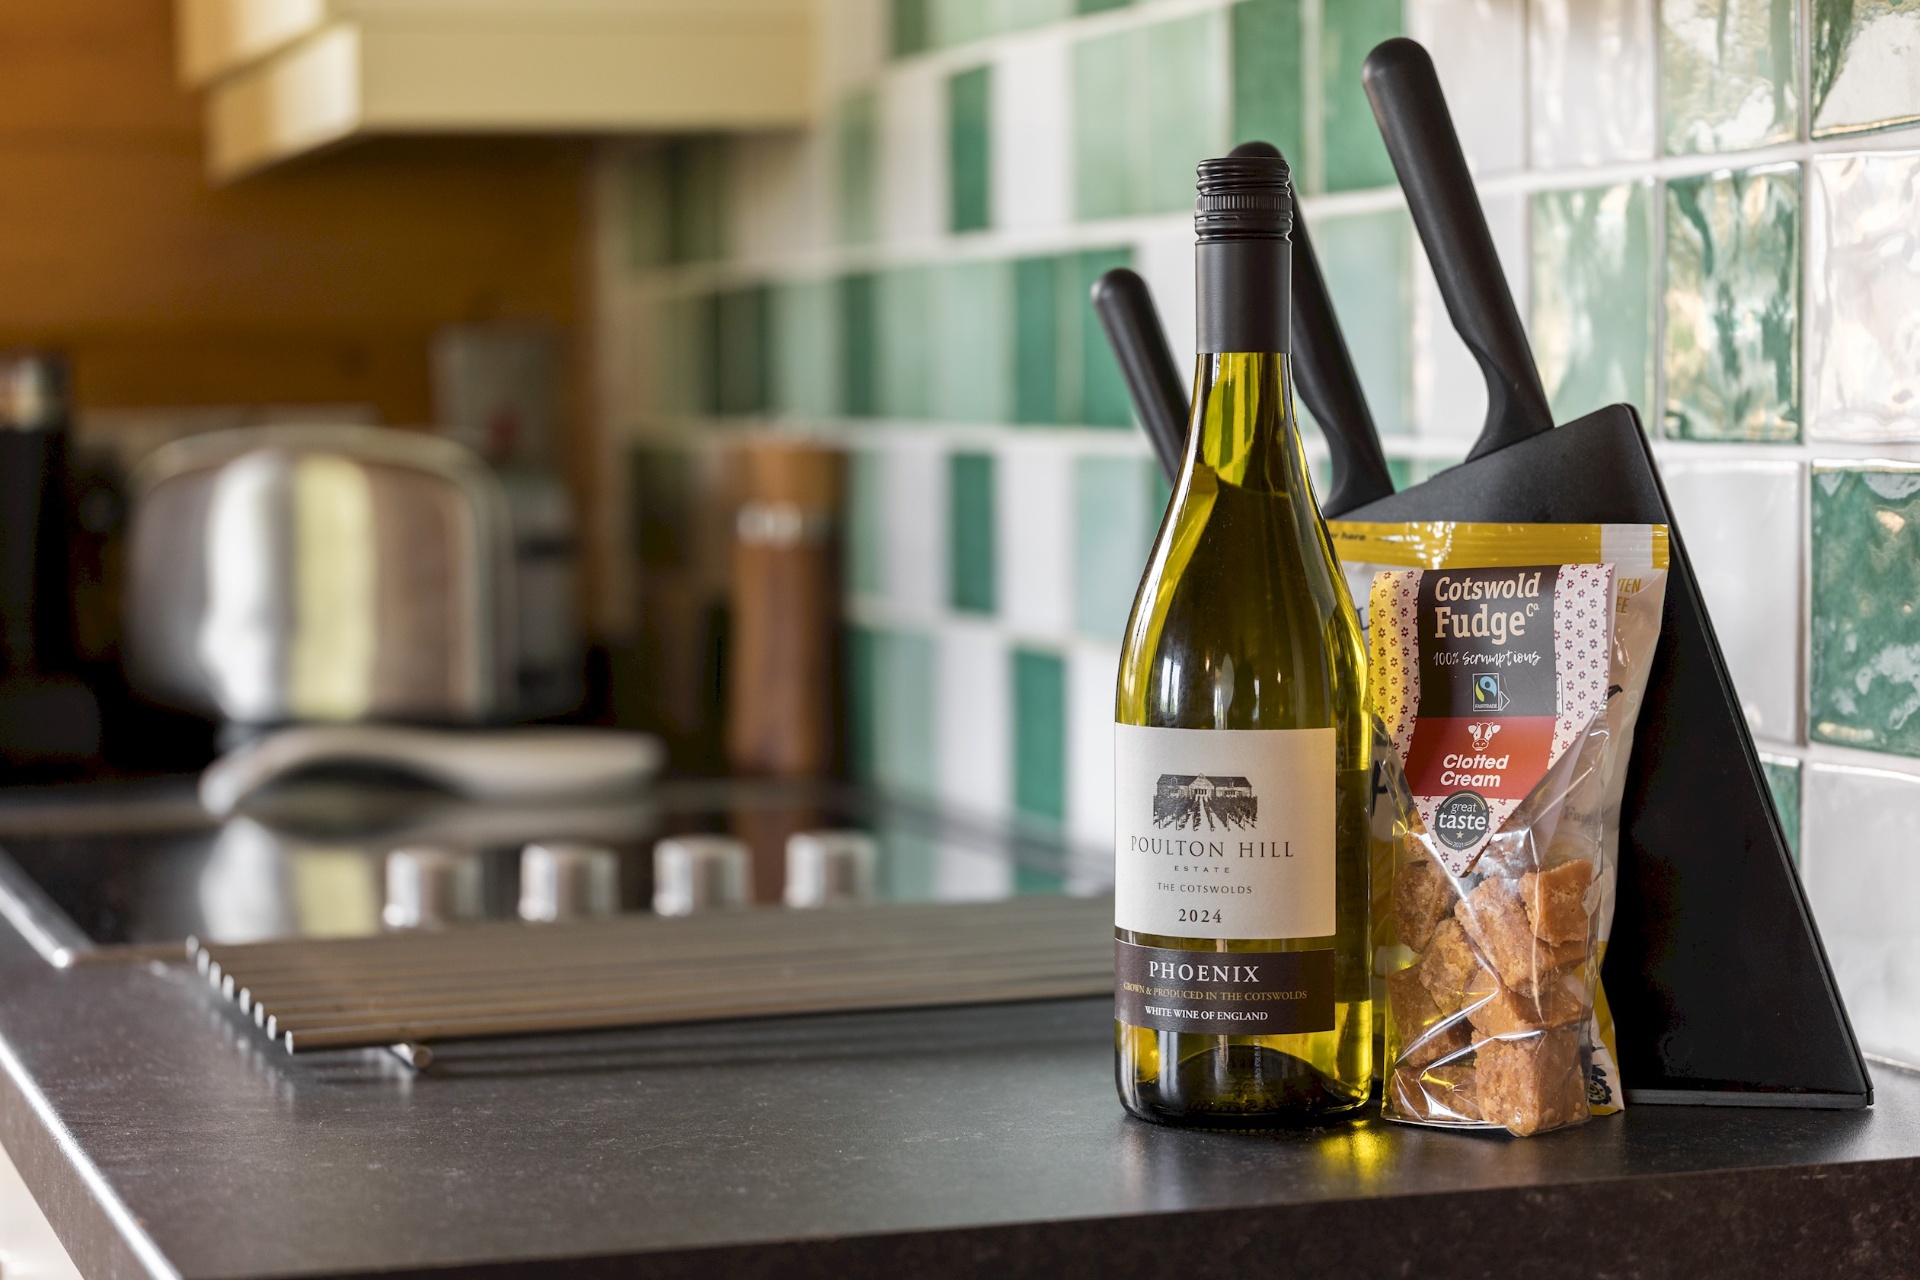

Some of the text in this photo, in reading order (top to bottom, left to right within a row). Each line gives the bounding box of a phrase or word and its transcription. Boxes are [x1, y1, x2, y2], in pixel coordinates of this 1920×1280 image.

[1435, 572, 1541, 602] Cotswold
[1435, 603, 1526, 645] Fudge
[1433, 651, 1459, 666] 100%
[1443, 753, 1510, 770] Clotted
[1440, 770, 1501, 787] Cream
[1450, 802, 1477, 814] great
[1438, 812, 1487, 831] taste
[1131, 835, 1294, 858] POULTON HILL
[1174, 865, 1230, 873] ESTATE
[1157, 882, 1253, 894] THE COTSWOLDS
[1178, 908, 1223, 923] 2024
[1149, 960, 1260, 983] PHOENIX
[1123, 981, 1308, 1001] GROWN & PRODUCED IN THE COTSWOLDS
[1145, 1005, 1269, 1021] WHITE WINE OF ENGLAND
